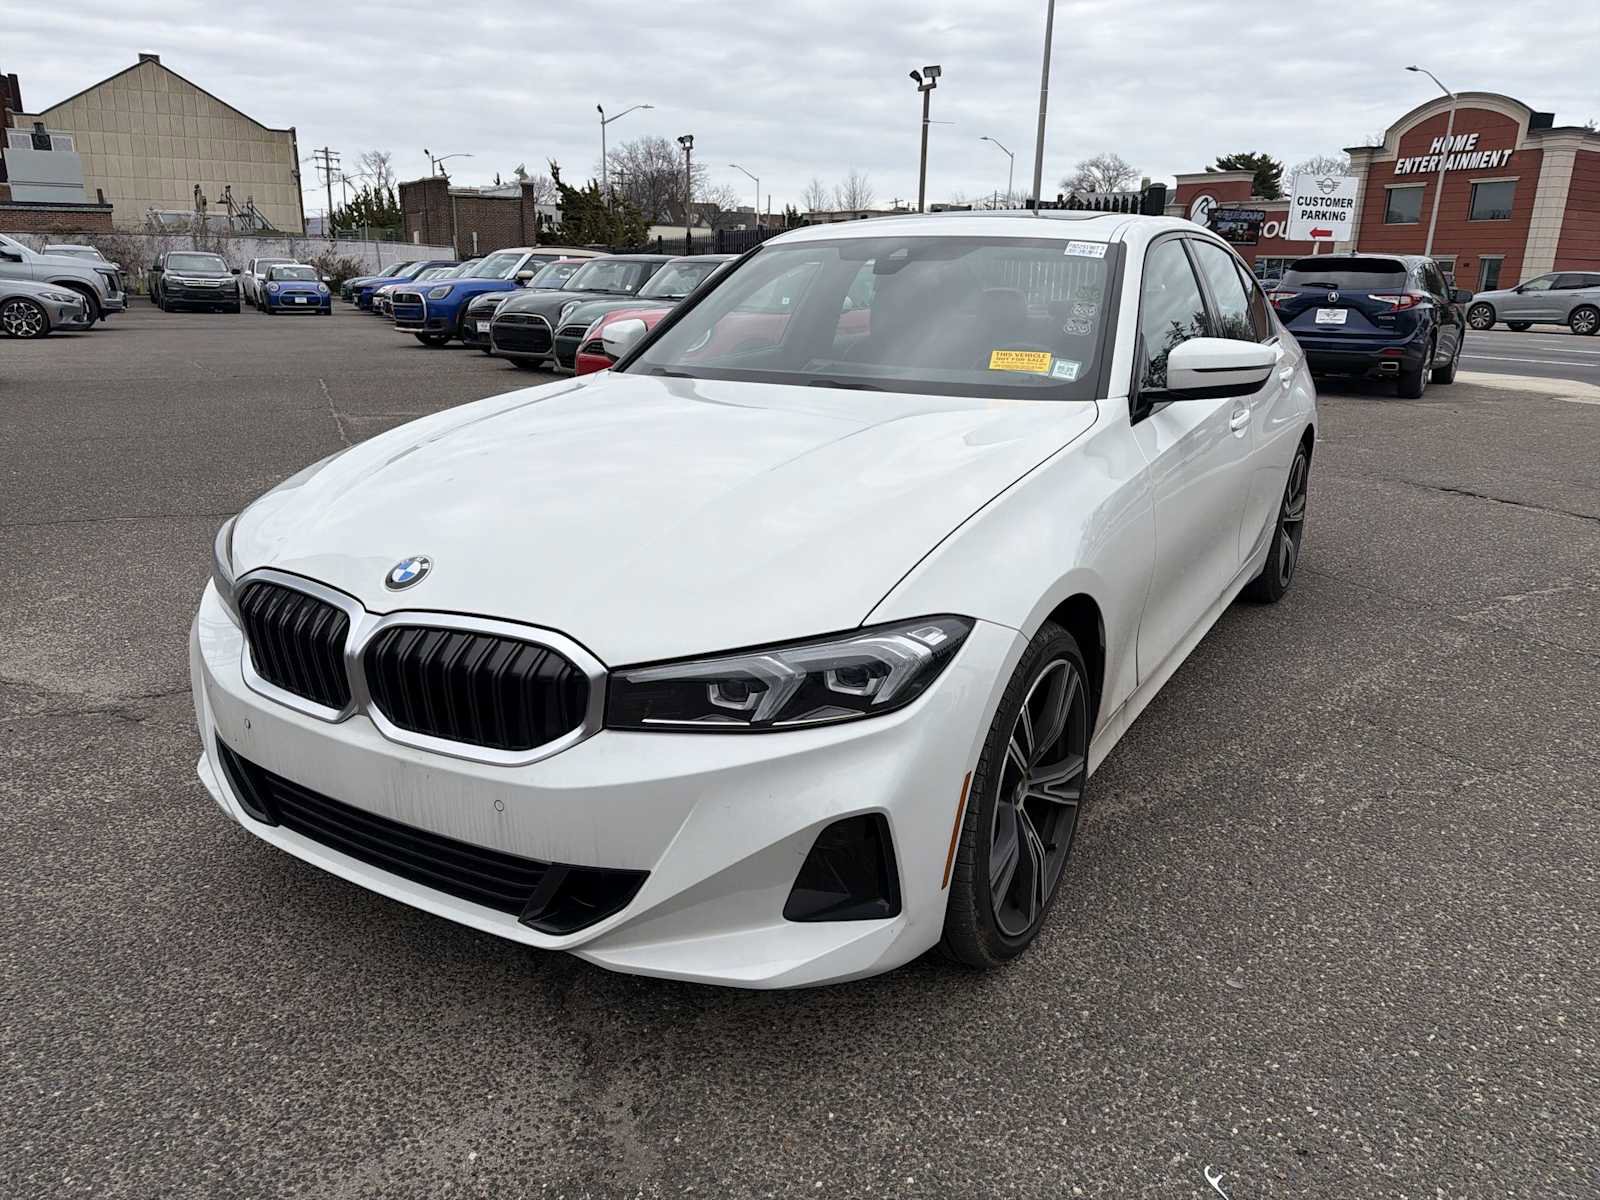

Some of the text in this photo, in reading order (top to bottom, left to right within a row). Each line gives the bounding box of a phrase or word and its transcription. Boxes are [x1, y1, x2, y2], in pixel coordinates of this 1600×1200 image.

[1429, 133, 1480, 154] HOME
[1297, 195, 1354, 209] CUSTOMER
[1300, 210, 1347, 222] PARKING
